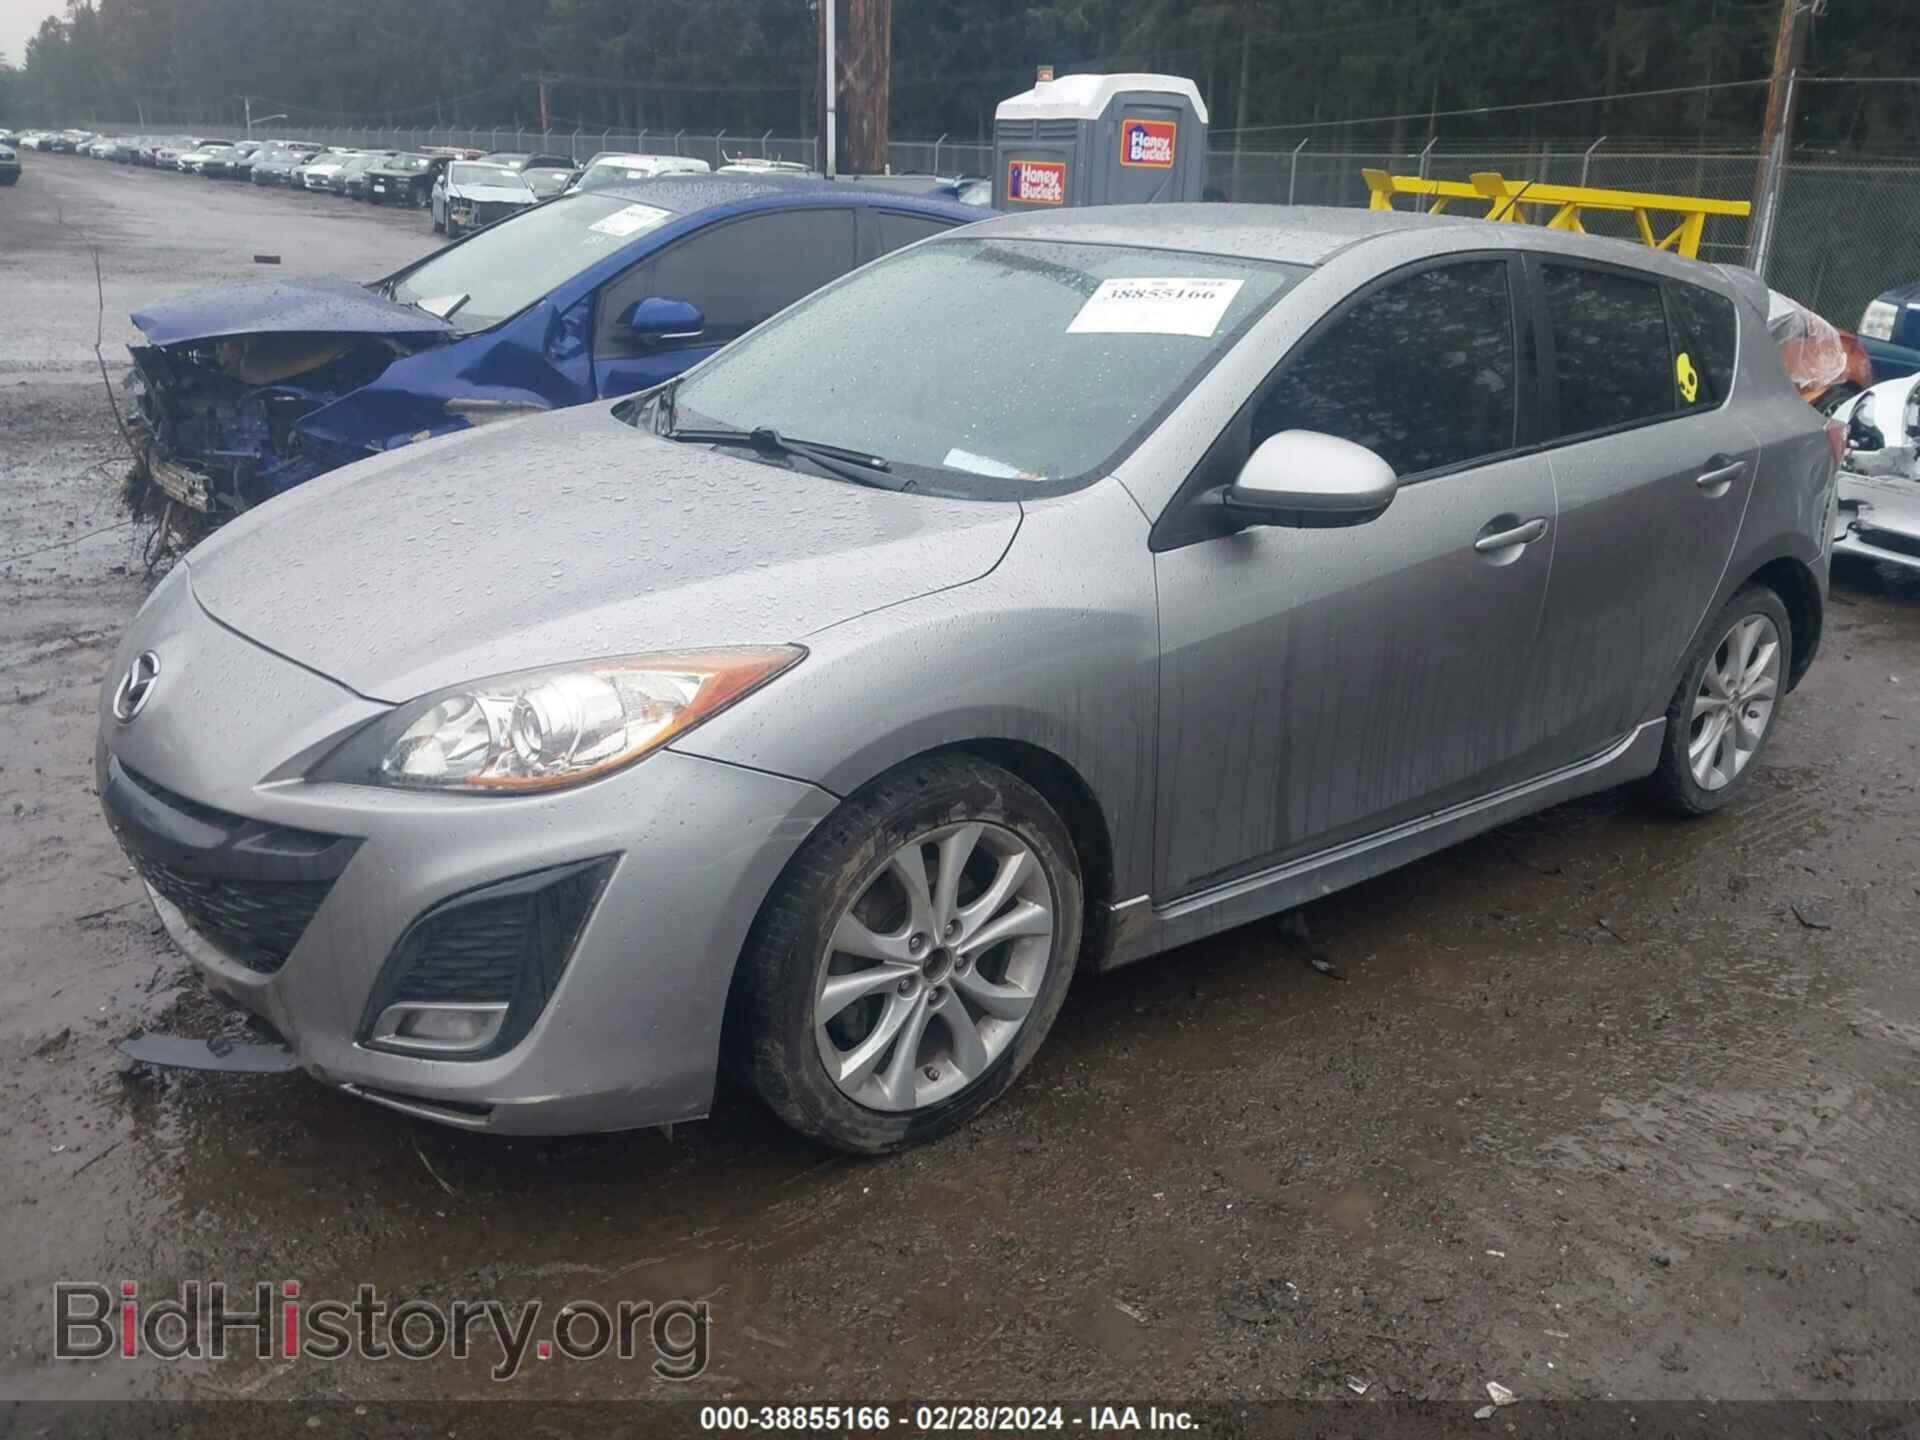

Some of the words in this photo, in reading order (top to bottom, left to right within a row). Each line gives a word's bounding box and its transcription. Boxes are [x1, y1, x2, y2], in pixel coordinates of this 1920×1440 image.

[1131, 131, 1169, 149] Honey
[1131, 145, 1171, 161] Bucket
[1021, 164, 1058, 186] Honey
[1020, 181, 1063, 200] Bucket
